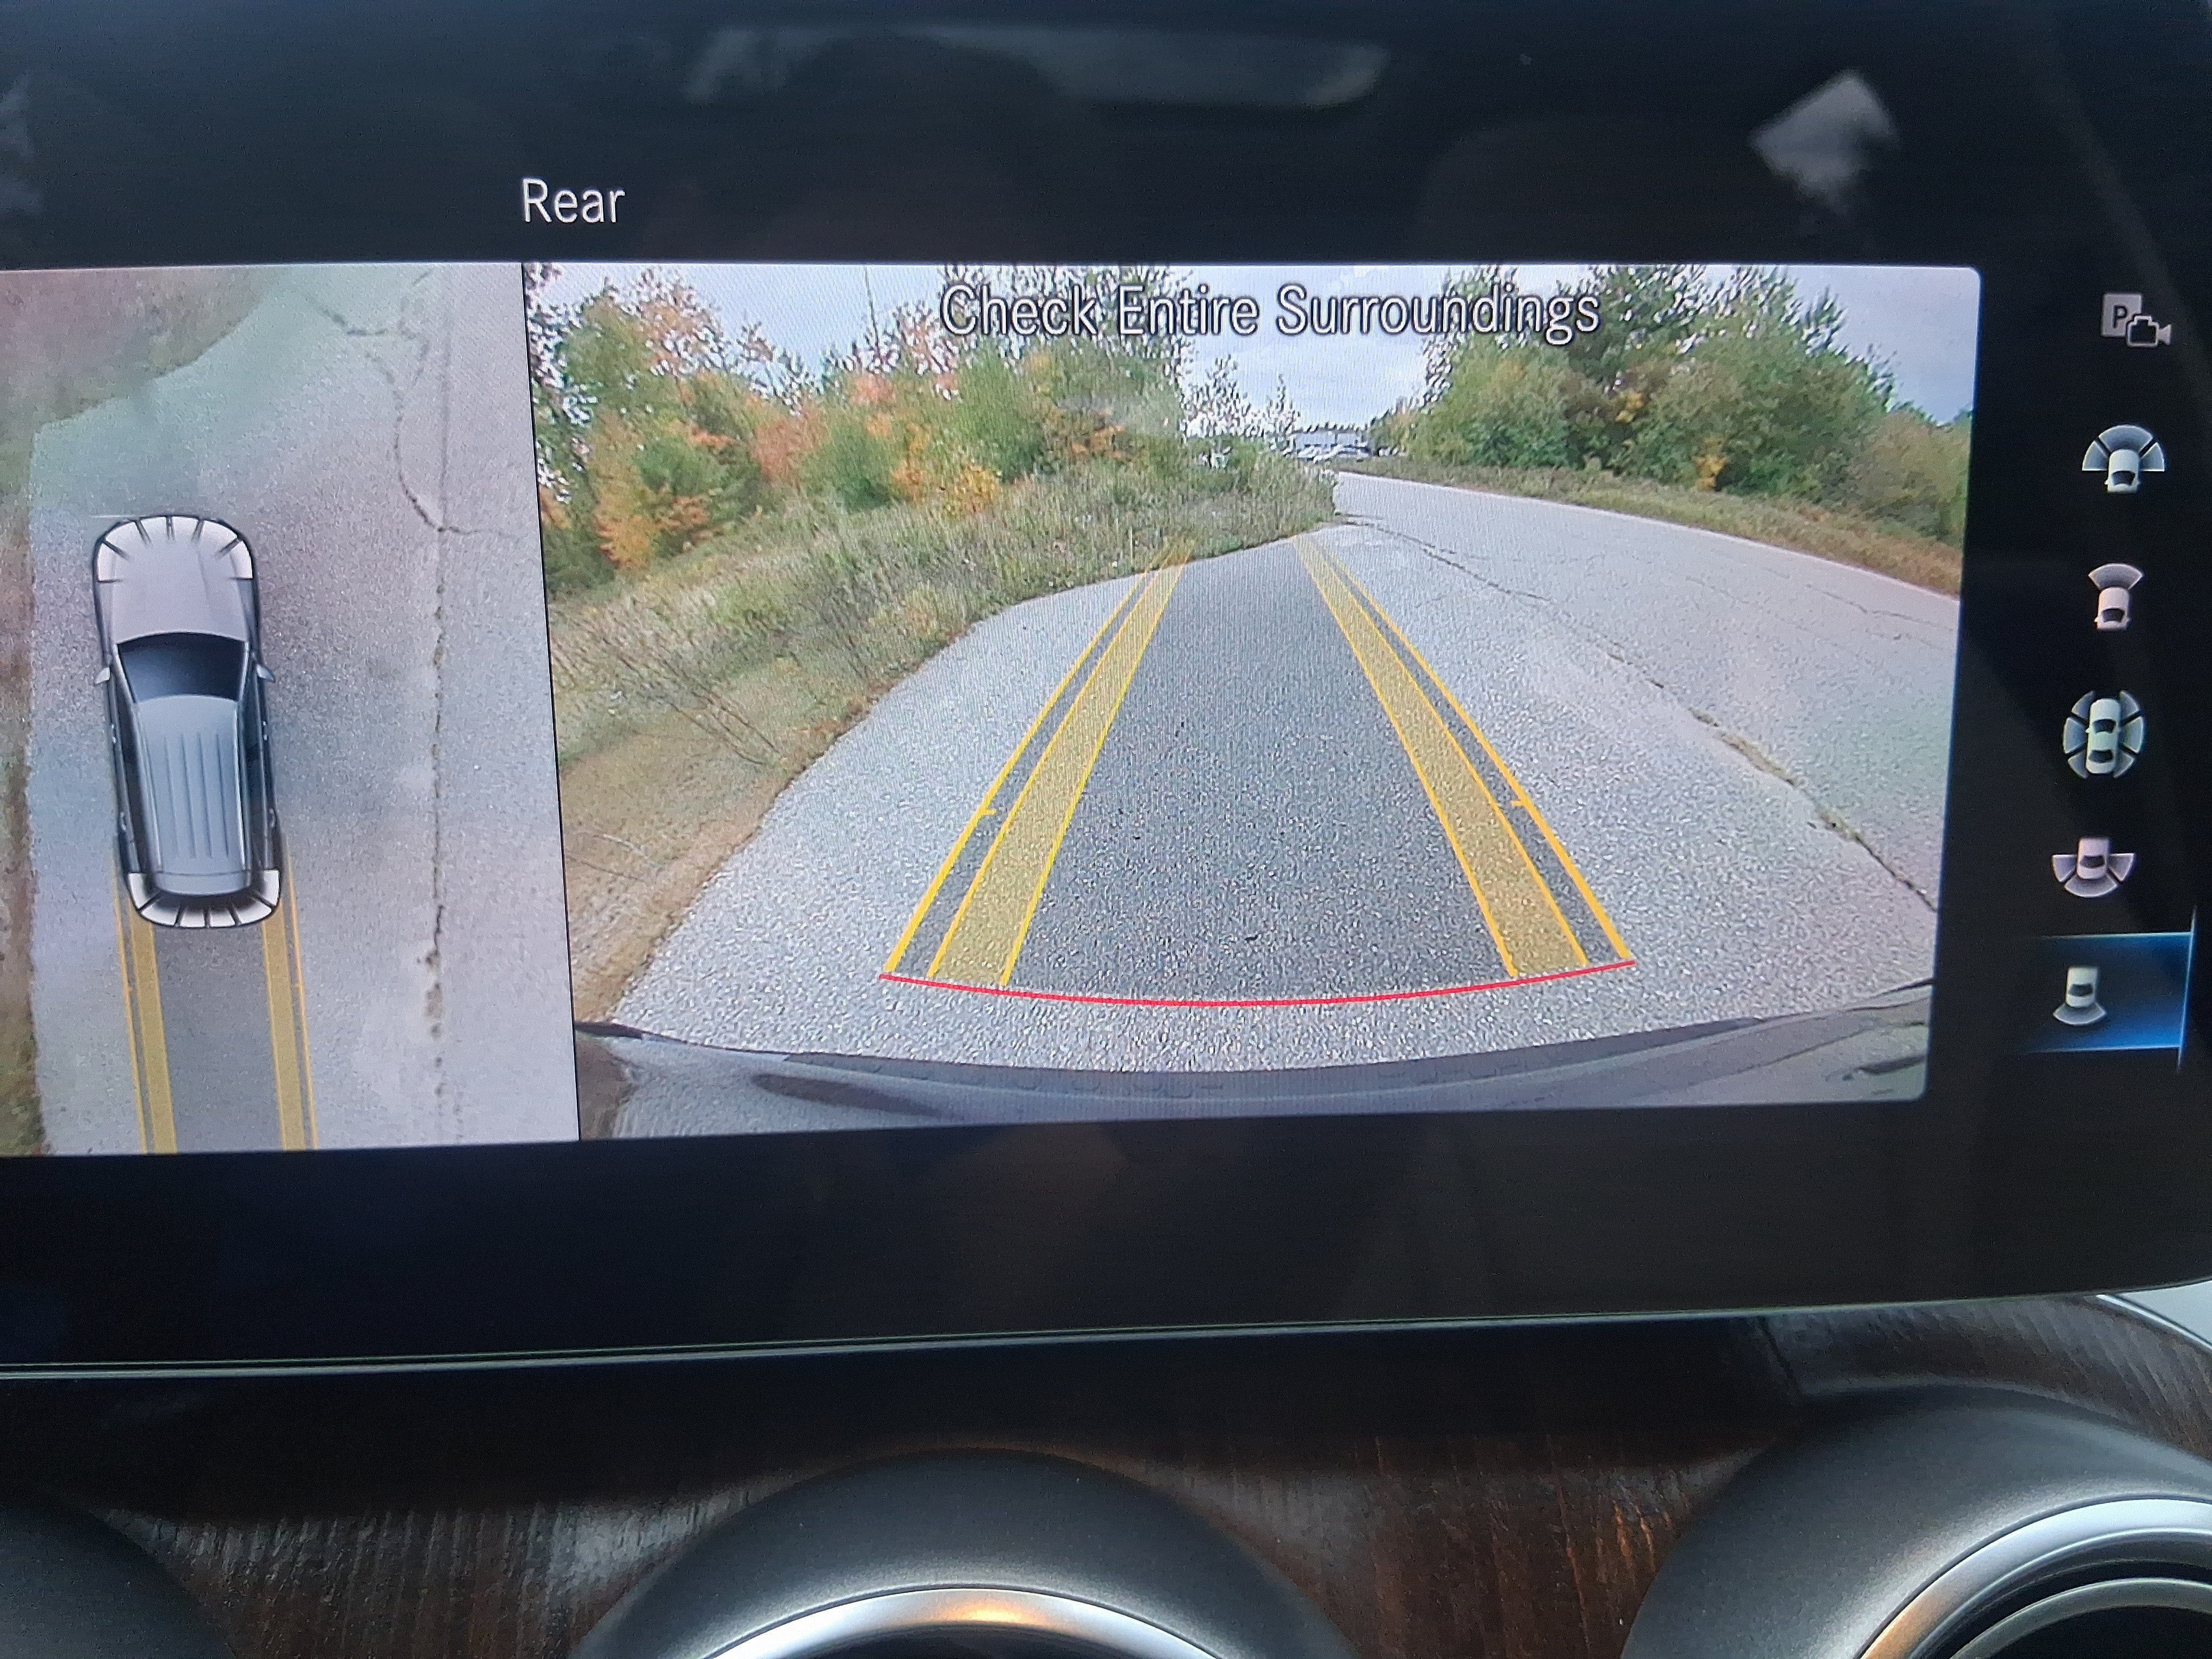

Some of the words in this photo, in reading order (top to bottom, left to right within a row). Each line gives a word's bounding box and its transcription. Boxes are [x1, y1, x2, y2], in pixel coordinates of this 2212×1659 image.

[522, 177, 626, 223] Rear
[941, 284, 1099, 336] Check
[1118, 283, 1259, 336] Entire
[1277, 279, 1601, 346] Surroundings
[2112, 305, 2127, 329] P
